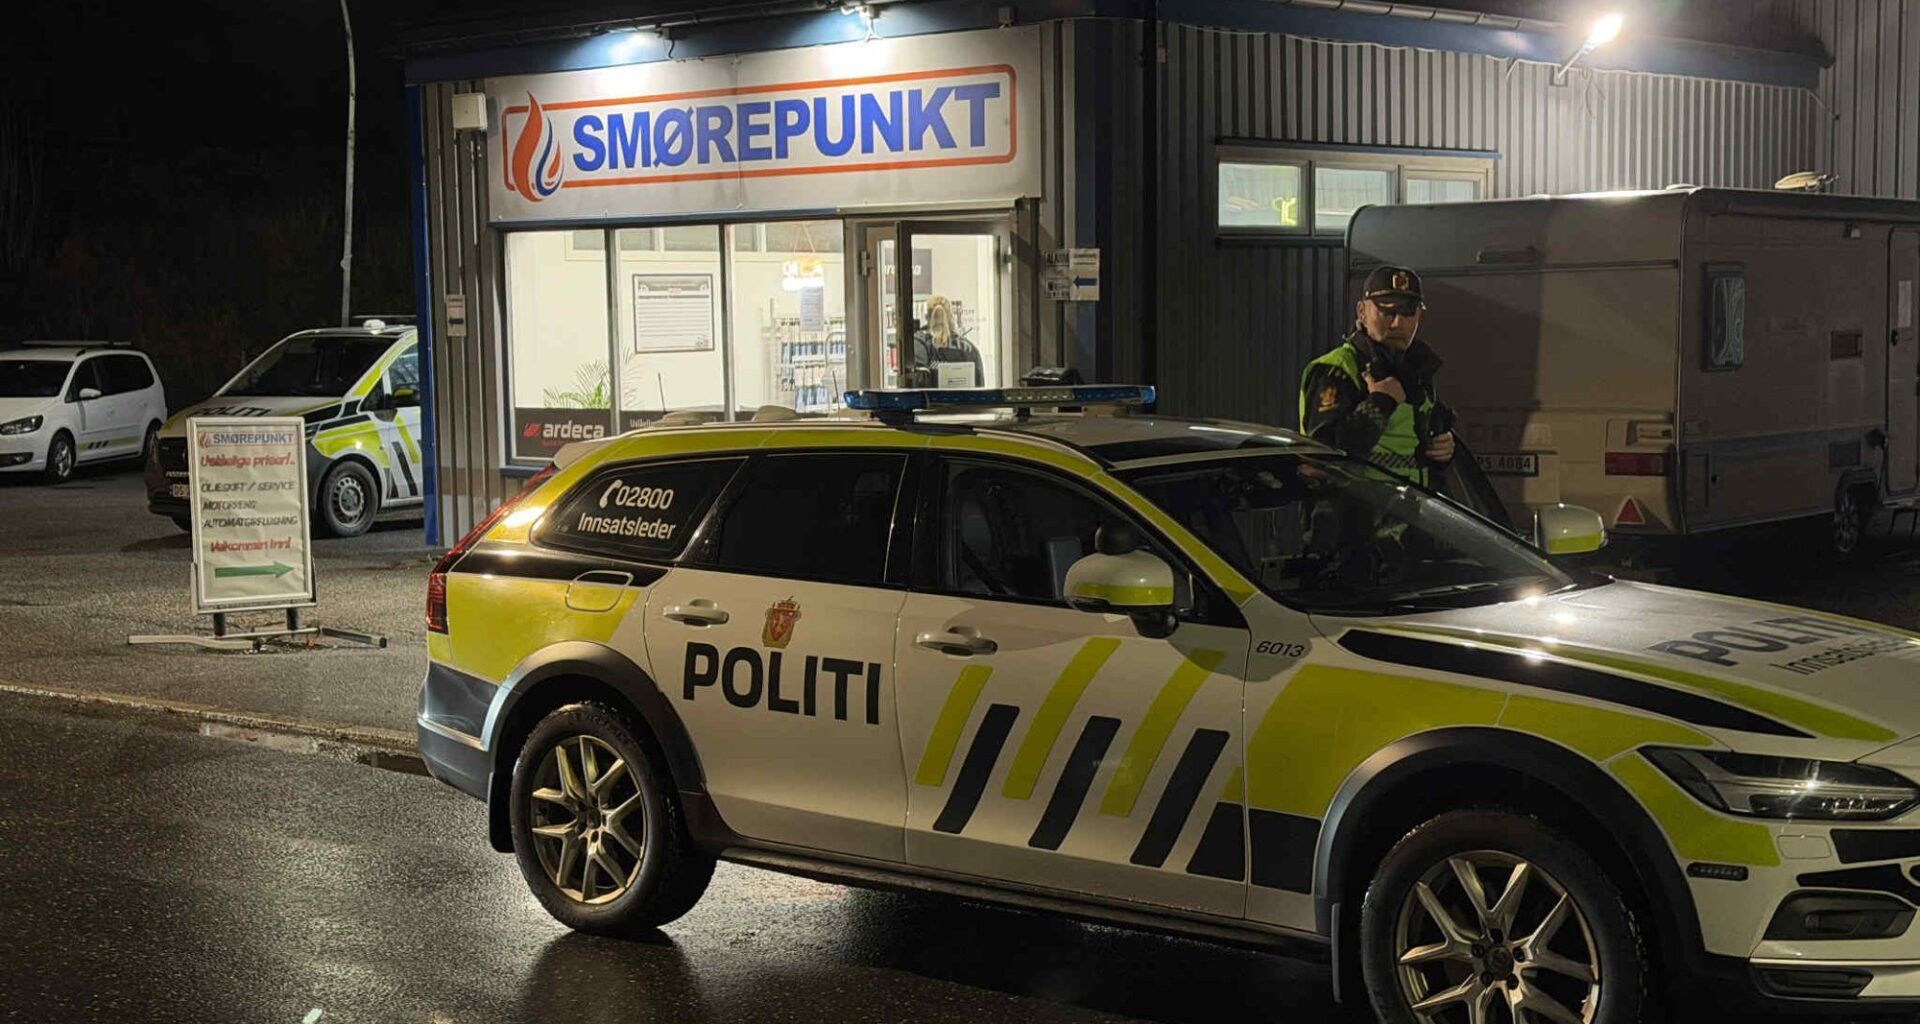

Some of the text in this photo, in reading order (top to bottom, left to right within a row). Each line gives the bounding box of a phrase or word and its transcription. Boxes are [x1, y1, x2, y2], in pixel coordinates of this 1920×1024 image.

[572, 82, 1000, 173] SMØREPUNKT
[213, 433, 294, 444] SMØREPUNKT
[542, 420, 605, 439] ardeca
[257, 480, 296, 491] SERVICE
[615, 485, 674, 510] 02800
[577, 512, 676, 540] Innsatsleder
[1256, 640, 1305, 658] 6013
[683, 641, 882, 725] POLITI
